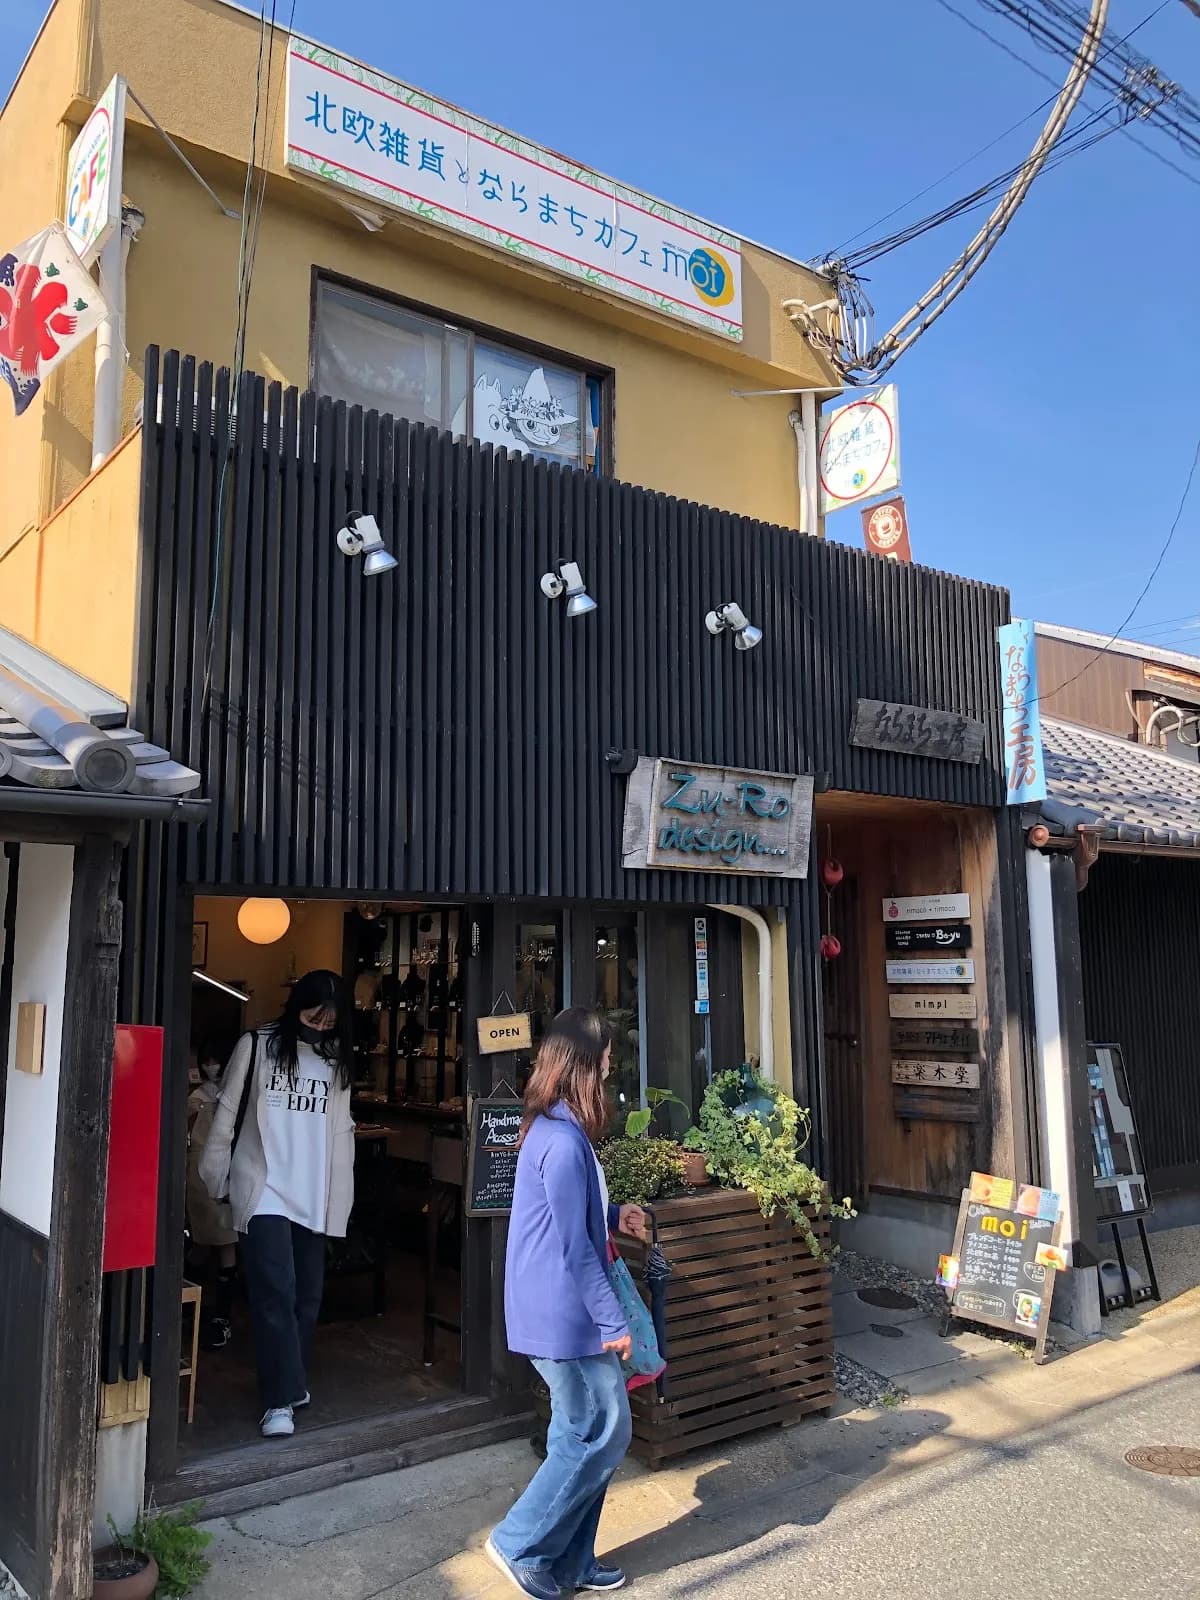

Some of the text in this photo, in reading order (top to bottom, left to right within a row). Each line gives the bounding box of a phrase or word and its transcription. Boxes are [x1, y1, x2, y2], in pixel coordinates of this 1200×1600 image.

[68, 136, 108, 228] CAFE
[305, 90, 653, 267] 北欧雑貨とならまちカフェ
[1004, 645, 1036, 790] ならまち工房
[664, 773, 790, 819] Zu-Ro
[489, 1027, 520, 1039] OPEN
[265, 1074, 331, 1099] EAUTY
[287, 1093, 329, 1114] EDIT
[981, 1216, 1030, 1240] moi
